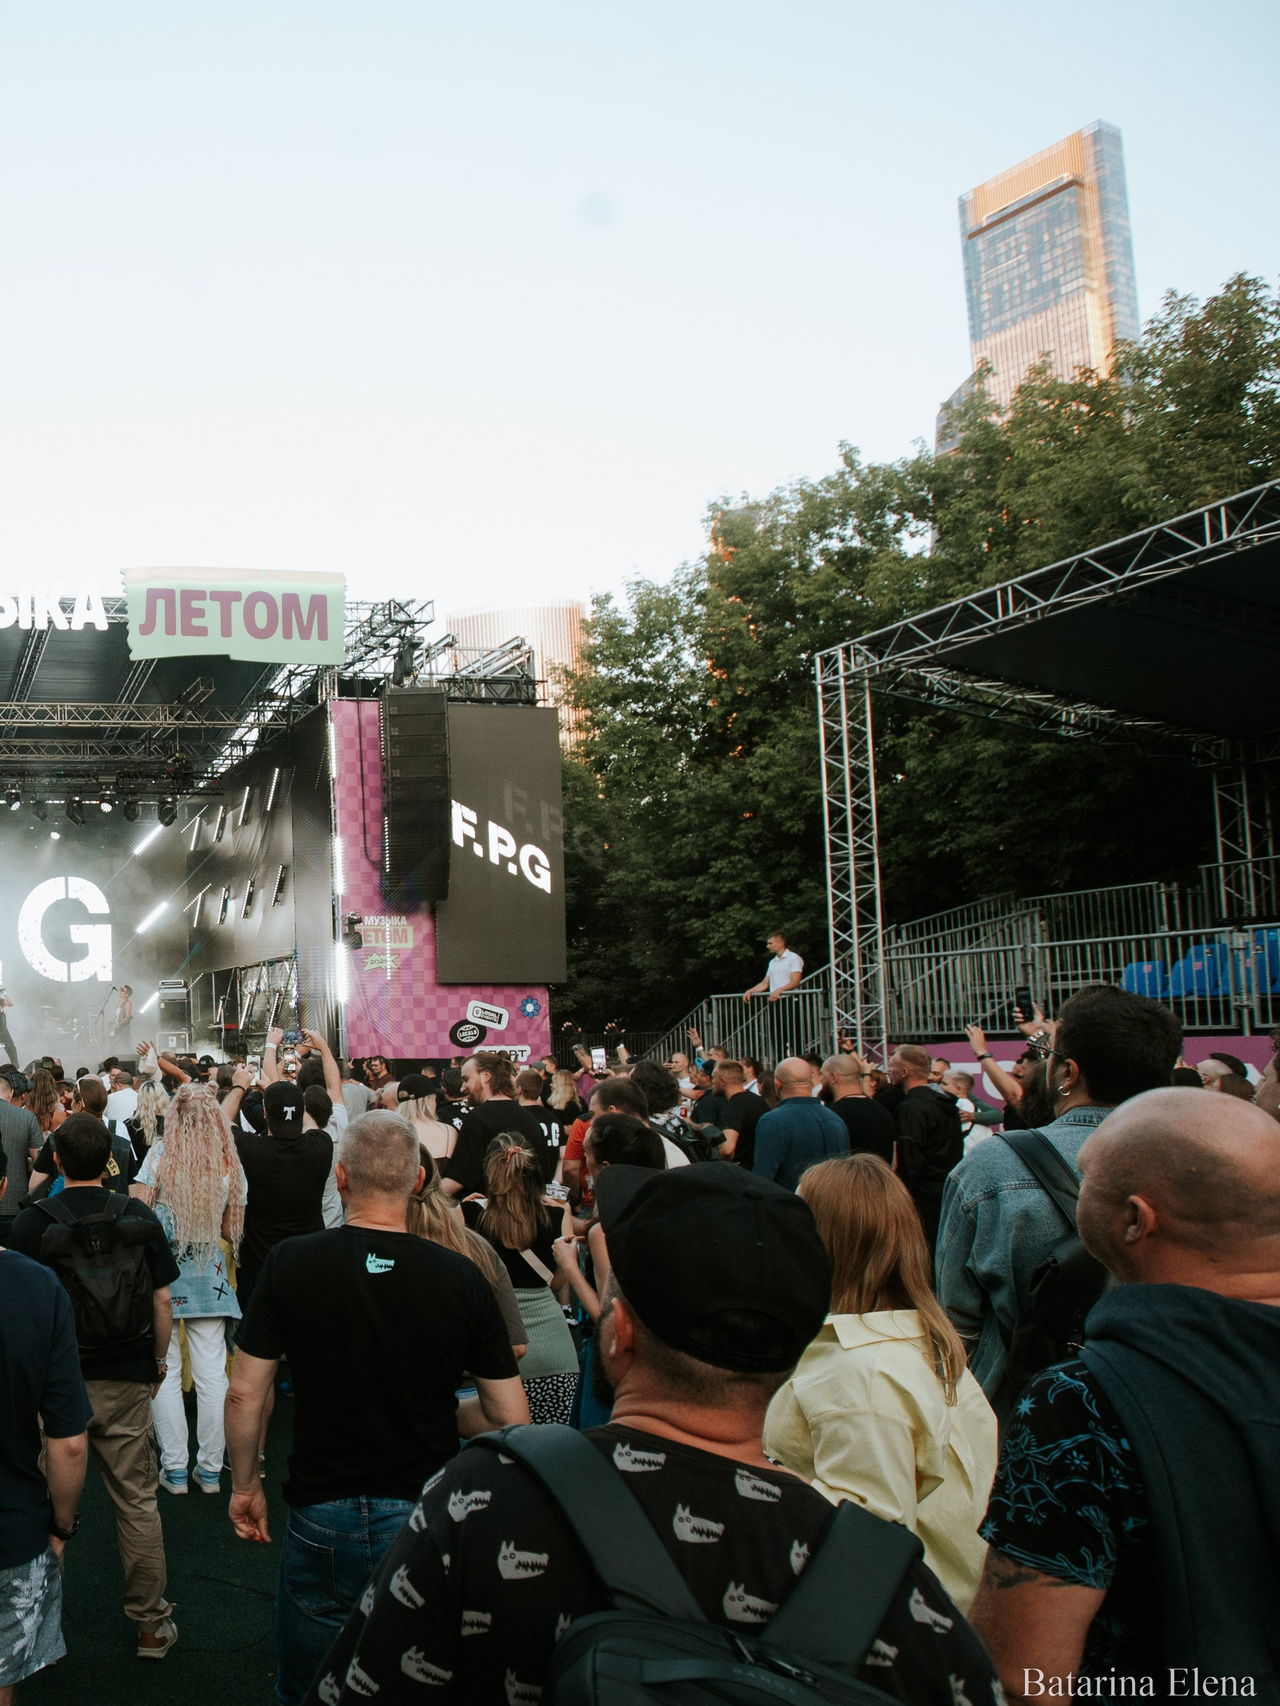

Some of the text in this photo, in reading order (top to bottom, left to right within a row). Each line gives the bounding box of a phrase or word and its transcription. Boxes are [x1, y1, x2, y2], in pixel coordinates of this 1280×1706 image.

[139, 587, 328, 641] ЛЕТОМ
[451, 799, 551, 894] F.P.G
[357, 927, 408, 944] ЕТОМ
[364, 915, 407, 926] МУЗЫКА
